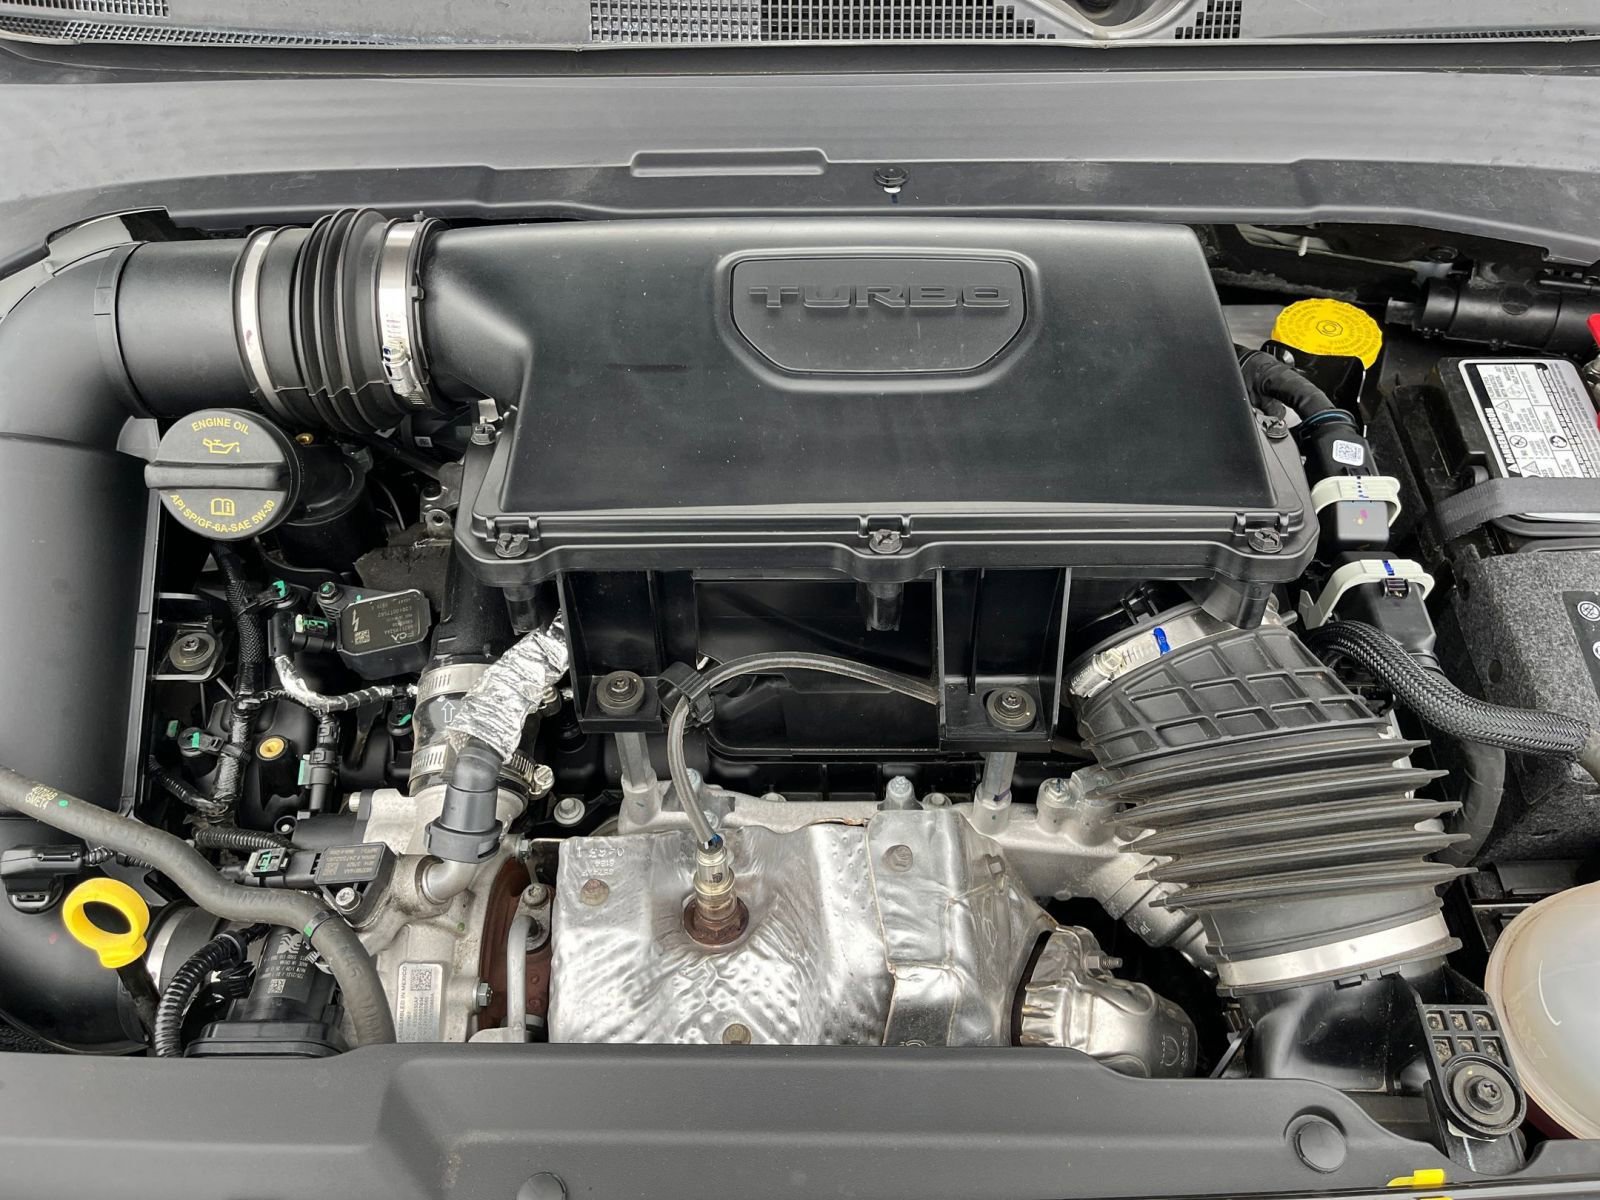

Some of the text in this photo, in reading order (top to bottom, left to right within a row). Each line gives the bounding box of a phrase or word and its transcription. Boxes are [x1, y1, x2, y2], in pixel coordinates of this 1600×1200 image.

[748, 283, 1011, 308] TURBO
[191, 417, 250, 435] ENGINE OIL
[1485, 407, 1515, 464] DANGER/POISON
[170, 493, 276, 533] API SP/GF-6A-SAE 5W-30
